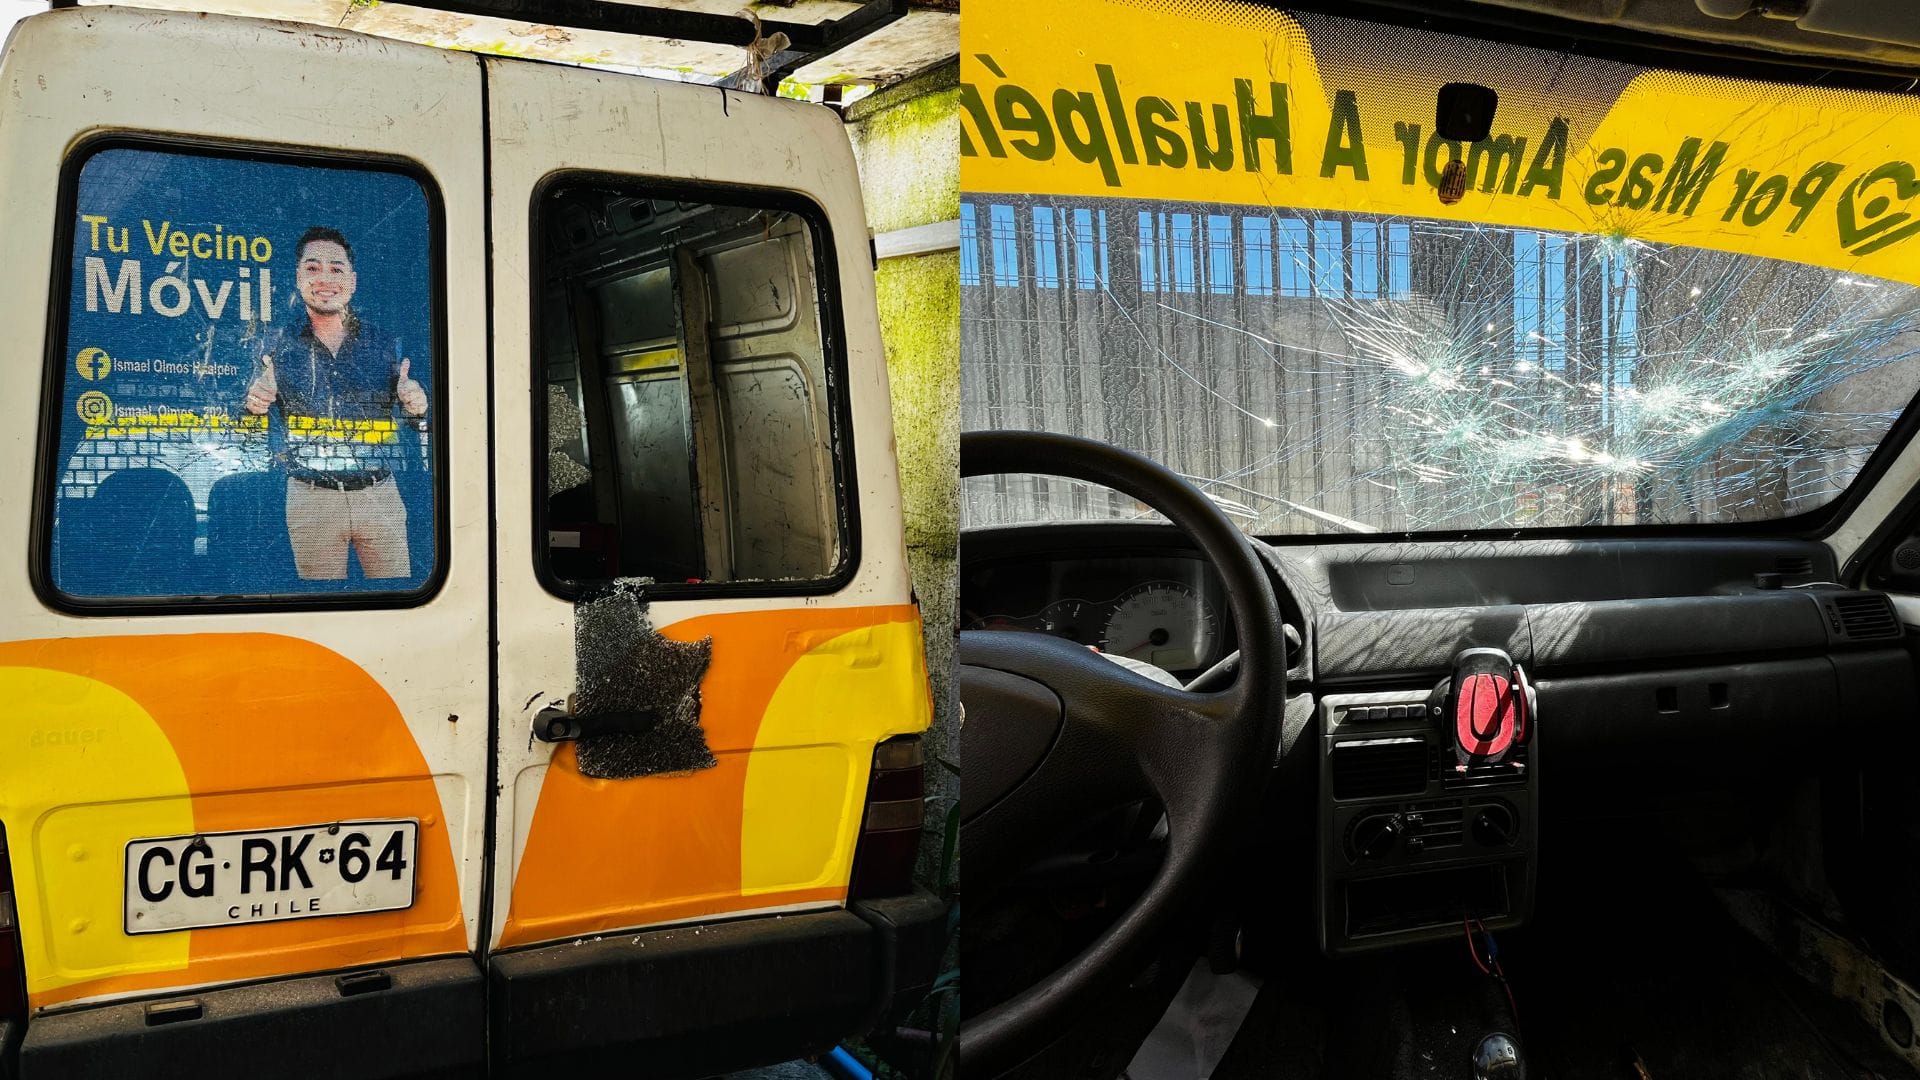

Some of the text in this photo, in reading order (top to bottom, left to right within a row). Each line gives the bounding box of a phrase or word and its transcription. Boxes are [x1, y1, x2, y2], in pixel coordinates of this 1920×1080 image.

[82, 214, 273, 263] Tu Vecino
[84, 256, 272, 322] Móvil
[113, 357, 150, 373] Ismael
[153, 359, 190, 374] Olmos
[228, 897, 320, 918] CHILE
